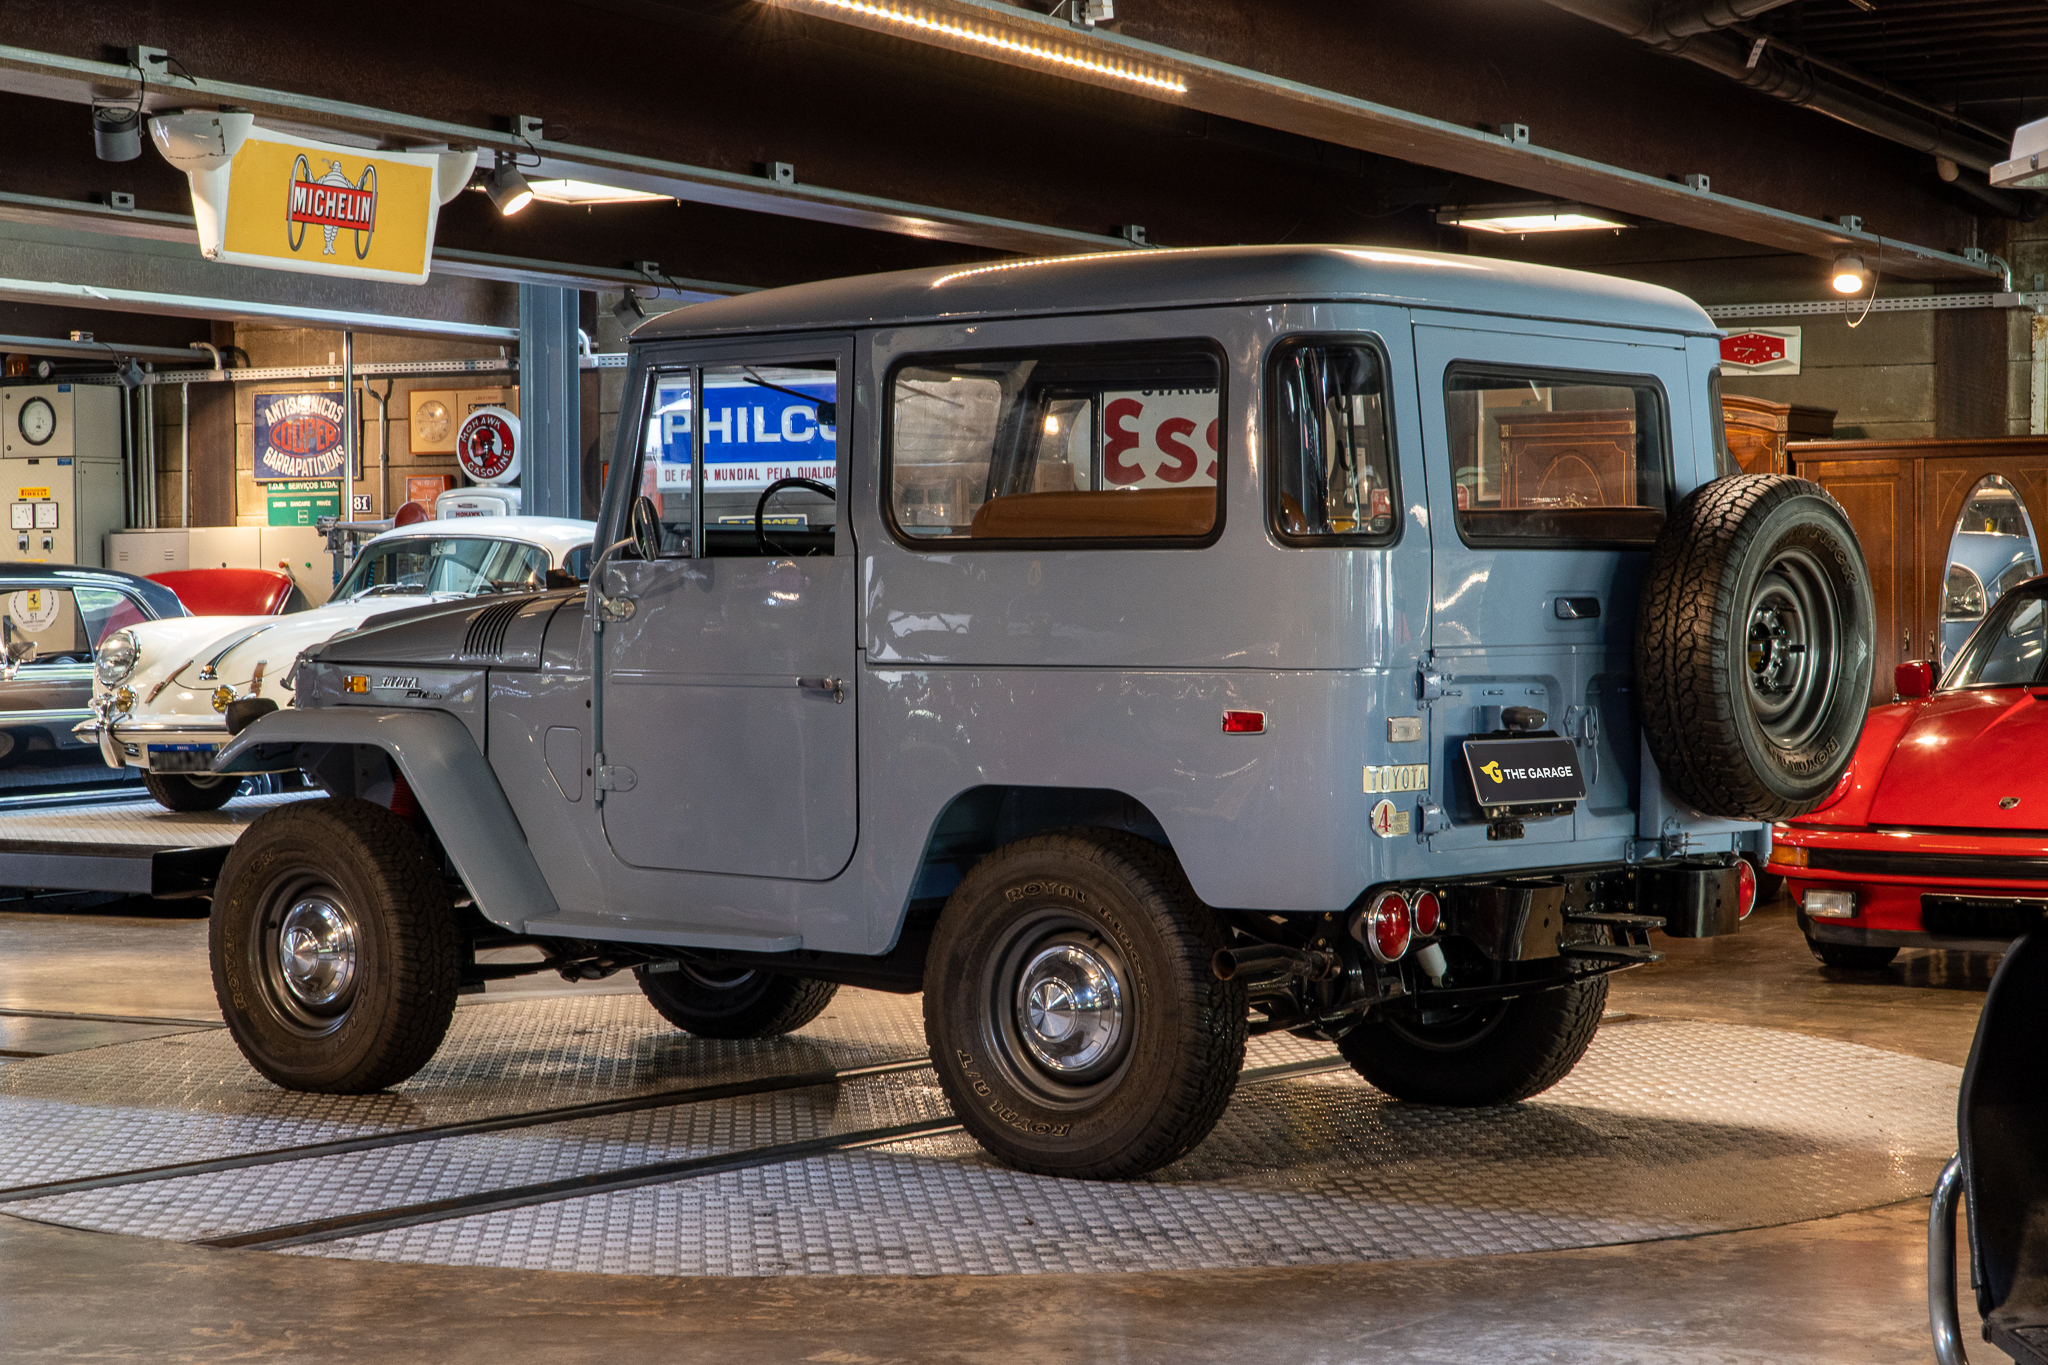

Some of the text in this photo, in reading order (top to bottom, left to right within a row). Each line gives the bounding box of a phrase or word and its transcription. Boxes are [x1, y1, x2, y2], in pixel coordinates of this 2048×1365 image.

[293, 186, 371, 223] MICHELIN
[265, 395, 345, 426] ANTISNICOS
[271, 417, 338, 454] COOPER
[461, 415, 502, 443] MOHAWK
[262, 444, 345, 477] GARRAPATICIDAS
[467, 449, 512, 478] GASOLINE
[665, 469, 676, 482] DE
[681, 468, 709, 482] FAA
[714, 467, 760, 481] MUNDIAL
[767, 467, 791, 481] PELA
[20, 488, 47, 497] PIRELLI
[288, 481, 319, 491] SERVIÇOS
[1366, 766, 1426, 791] TOYOTA
[1503, 768, 1528, 780] THE
[1528, 765, 1574, 779] GARAGE
[1377, 802, 1392, 834] 4
[1005, 881, 1150, 998] ROYAL BLACK
[956, 1049, 1071, 1137] ROYAL A/T
